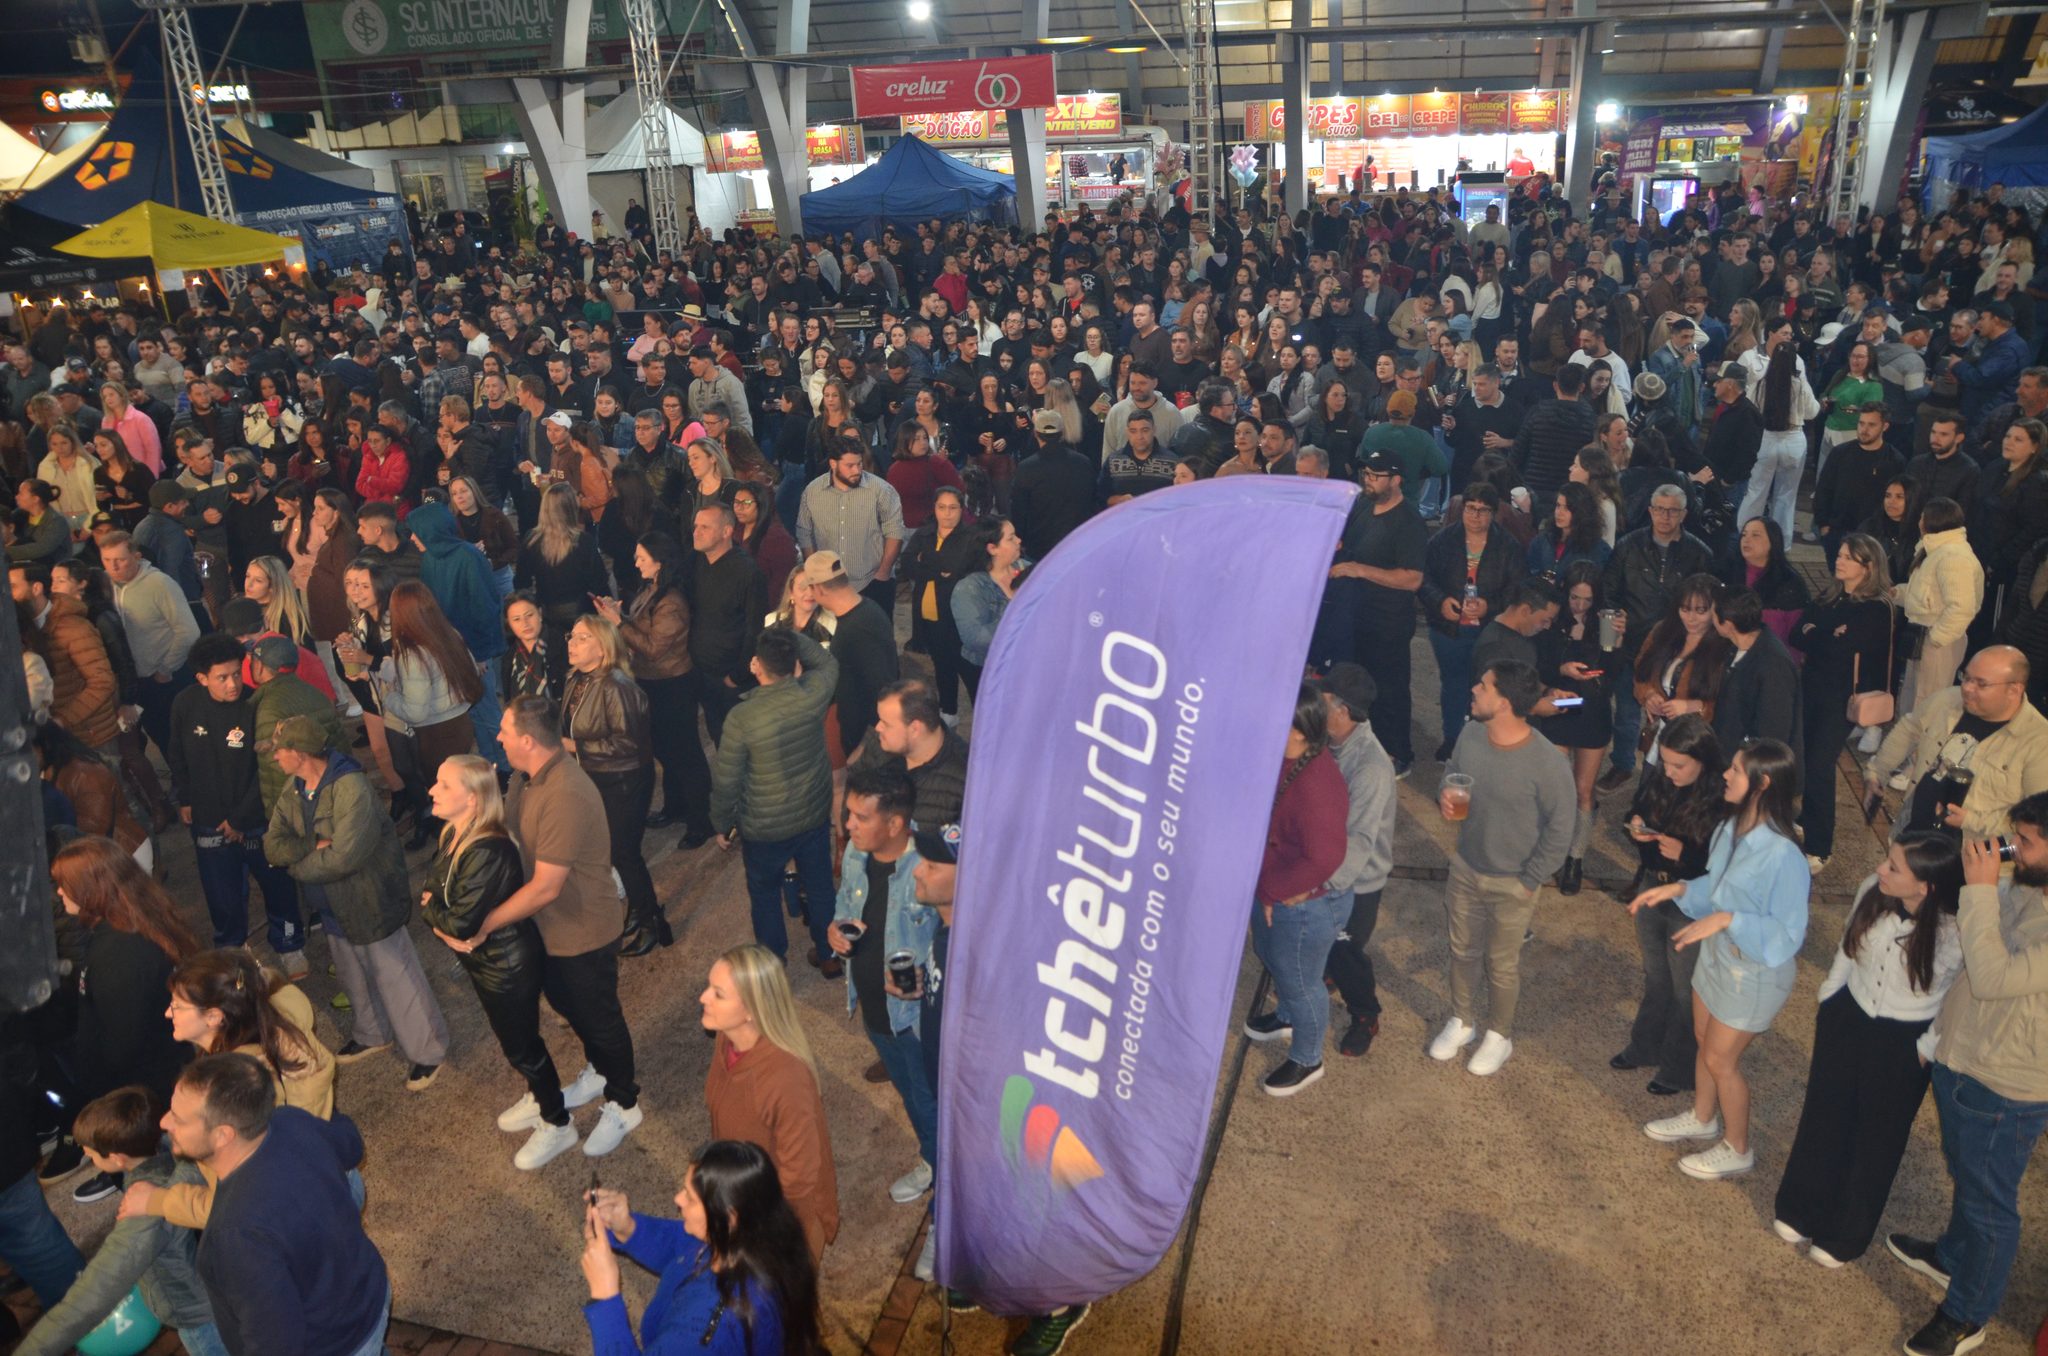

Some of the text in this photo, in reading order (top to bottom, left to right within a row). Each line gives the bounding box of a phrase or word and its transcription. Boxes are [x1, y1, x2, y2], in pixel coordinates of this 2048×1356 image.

[402, 2, 425, 33] SC
[408, 32, 473, 48] CONSULADO
[477, 27, 521, 42] OFICIAL
[526, 25, 544, 40] DE
[886, 75, 948, 98] creluz
[1054, 102, 1098, 119] XIS
[1462, 102, 1506, 112] CHURROS
[1512, 100, 1557, 111] CHURROS
[1045, 119, 1116, 131] NTREVERO
[1368, 112, 1399, 127] REI
[1413, 110, 1457, 125] CREPE
[813, 146, 833, 155] BRASA
[298, 202, 331, 215] VEICULAR
[332, 201, 355, 211] TOTAL
[377, 197, 394, 206] STAR
[369, 216, 387, 227] STAR
[1021, 630, 1169, 1101] tchêturbo
[1114, 677, 1206, 1102] conectada com o seu mundo.
